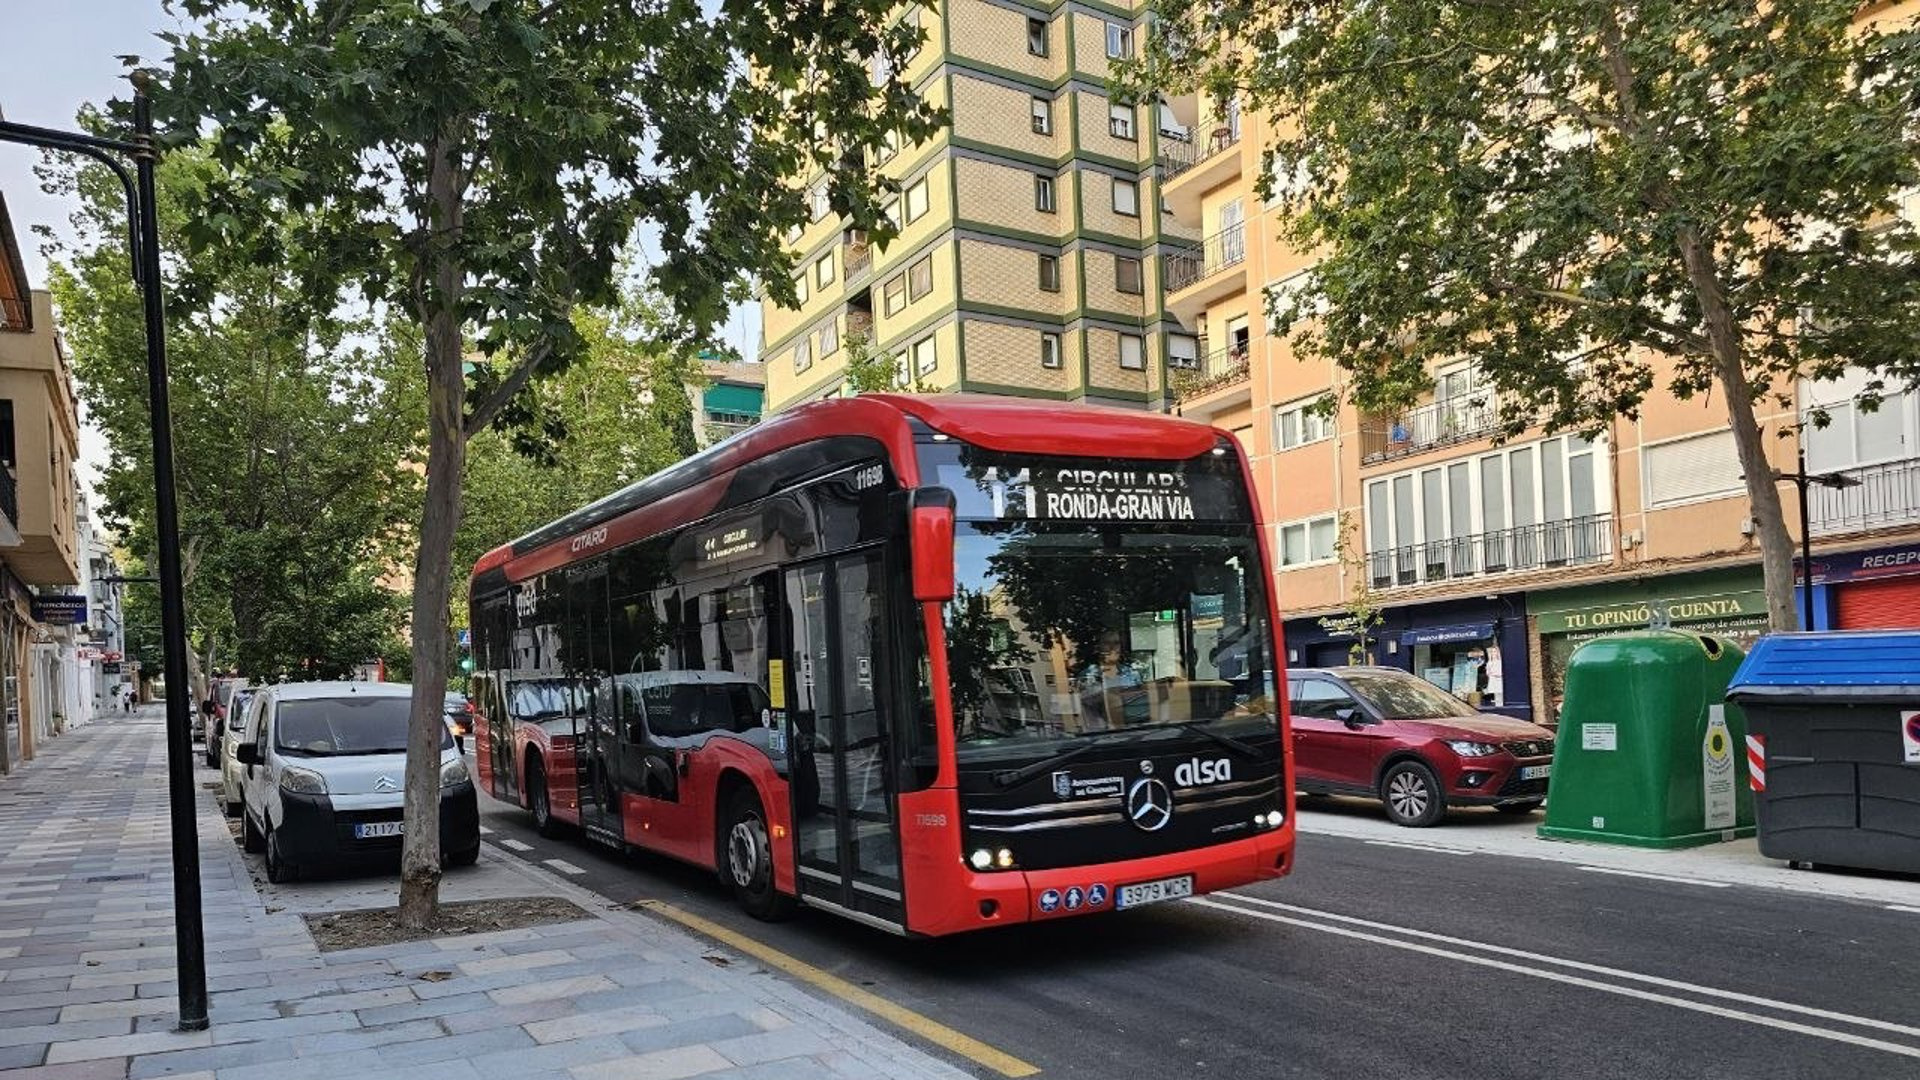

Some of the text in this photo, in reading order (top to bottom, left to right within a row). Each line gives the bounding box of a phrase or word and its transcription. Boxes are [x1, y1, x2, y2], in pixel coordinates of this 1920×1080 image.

[857, 464, 883, 490] 11698
[982, 466, 1036, 518] 11
[1047, 493, 1163, 519] RONDA-GRAN
[1862, 551, 1920, 568] RECEP
[1565, 613, 1587, 628] TU
[1668, 600, 1742, 619] CUENTA
[1174, 758, 1232, 786] alsa
[365, 823, 394, 836] 2117
[1126, 884, 1160, 904] 3979
